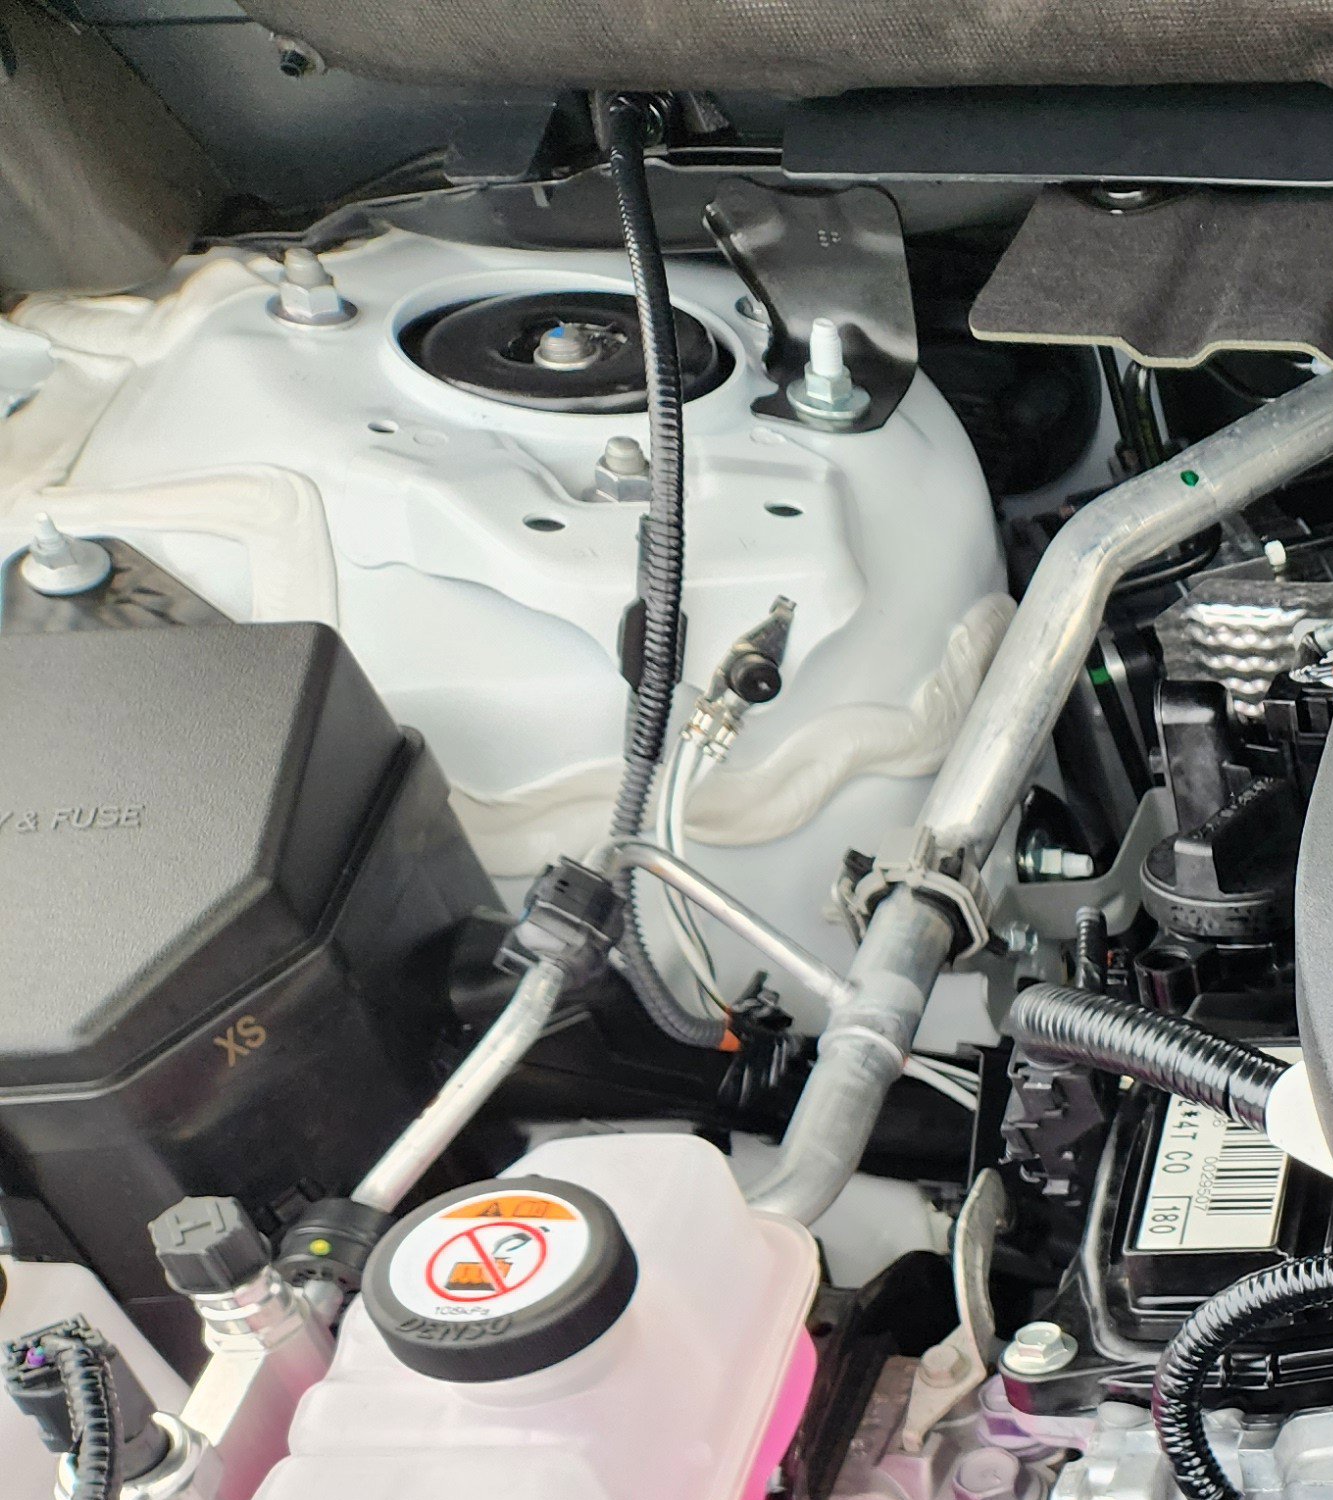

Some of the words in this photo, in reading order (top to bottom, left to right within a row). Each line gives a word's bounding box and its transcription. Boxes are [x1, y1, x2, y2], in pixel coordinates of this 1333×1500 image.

[52, 803, 146, 831] FUSE
[213, 1014, 266, 1067] XS
[1161, 1150, 1193, 1174] CO
[1194, 1157, 1220, 1213] 0029507
[1149, 1205, 1181, 1235] 180
[396, 1316, 513, 1342] DENSO
